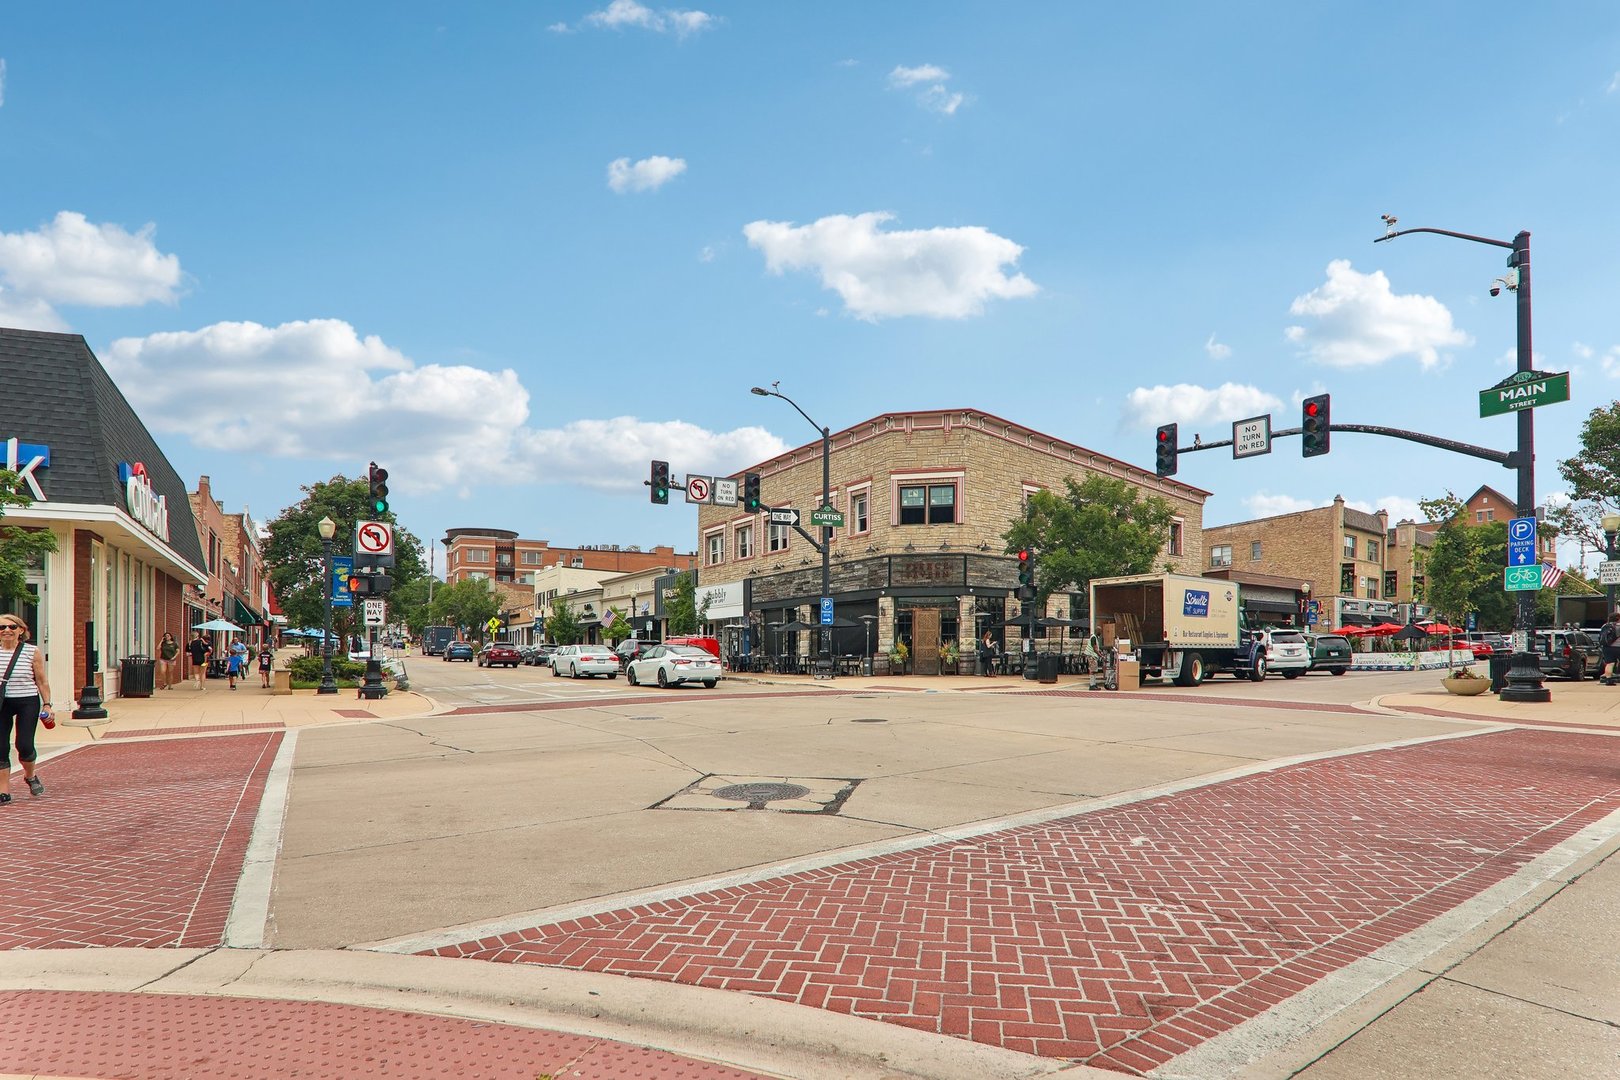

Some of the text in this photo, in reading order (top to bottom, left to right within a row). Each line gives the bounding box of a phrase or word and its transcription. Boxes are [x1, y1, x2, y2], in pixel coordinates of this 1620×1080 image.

[1500, 382, 1547, 402] MAIN
[1509, 399, 1537, 410] STREET
[1242, 433, 1261, 441] TURN
[1250, 441, 1265, 449] RED
[773, 513, 792, 521] ONE WAY
[813, 512, 842, 521] CURTISS
[1516, 523, 1528, 537] P
[1510, 540, 1534, 548] PARKING
[1185, 592, 1208, 606] Schultz
